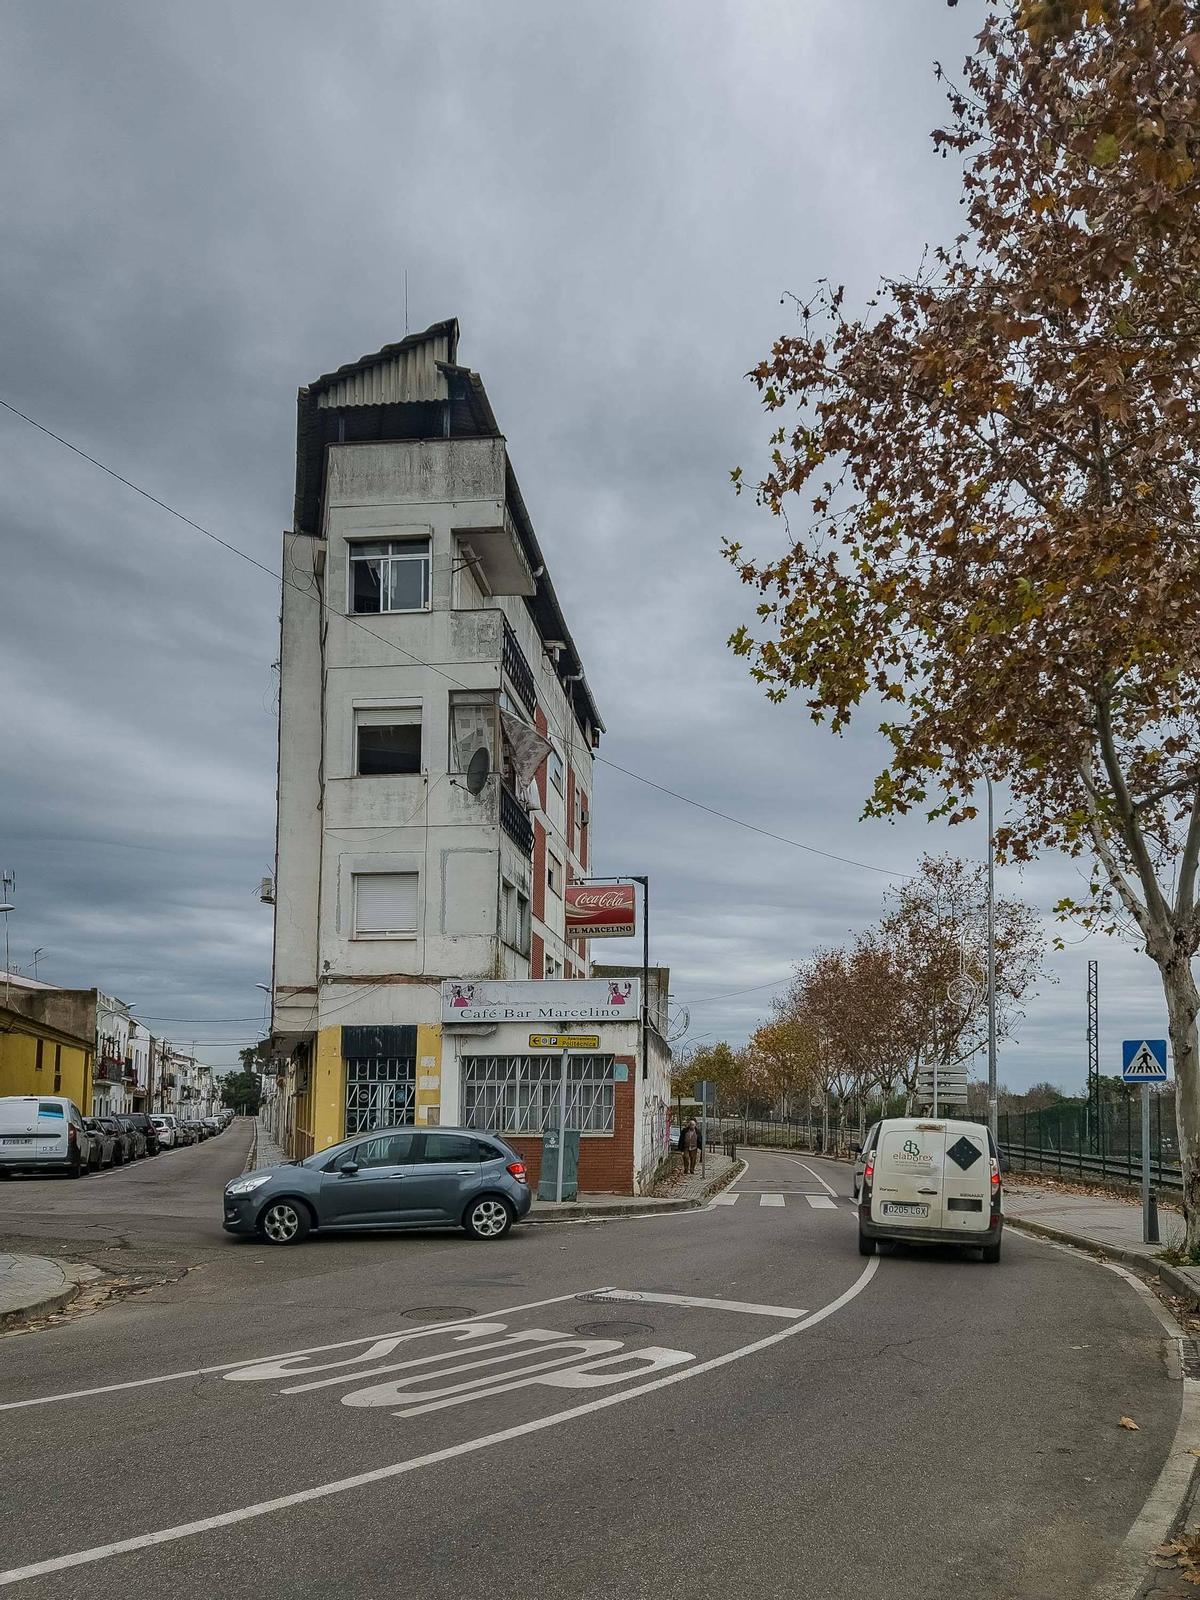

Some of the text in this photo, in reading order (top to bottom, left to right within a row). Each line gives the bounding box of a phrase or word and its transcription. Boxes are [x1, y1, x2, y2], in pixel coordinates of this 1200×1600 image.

[575, 891, 625, 908] Coca-Cola
[581, 925, 632, 934] MARCELINO
[537, 1007, 621, 1018] Marcelino
[892, 1152, 934, 1162] elaborex
[888, 1205, 909, 1214] 0205
[222, 1323, 697, 1418] STOP
